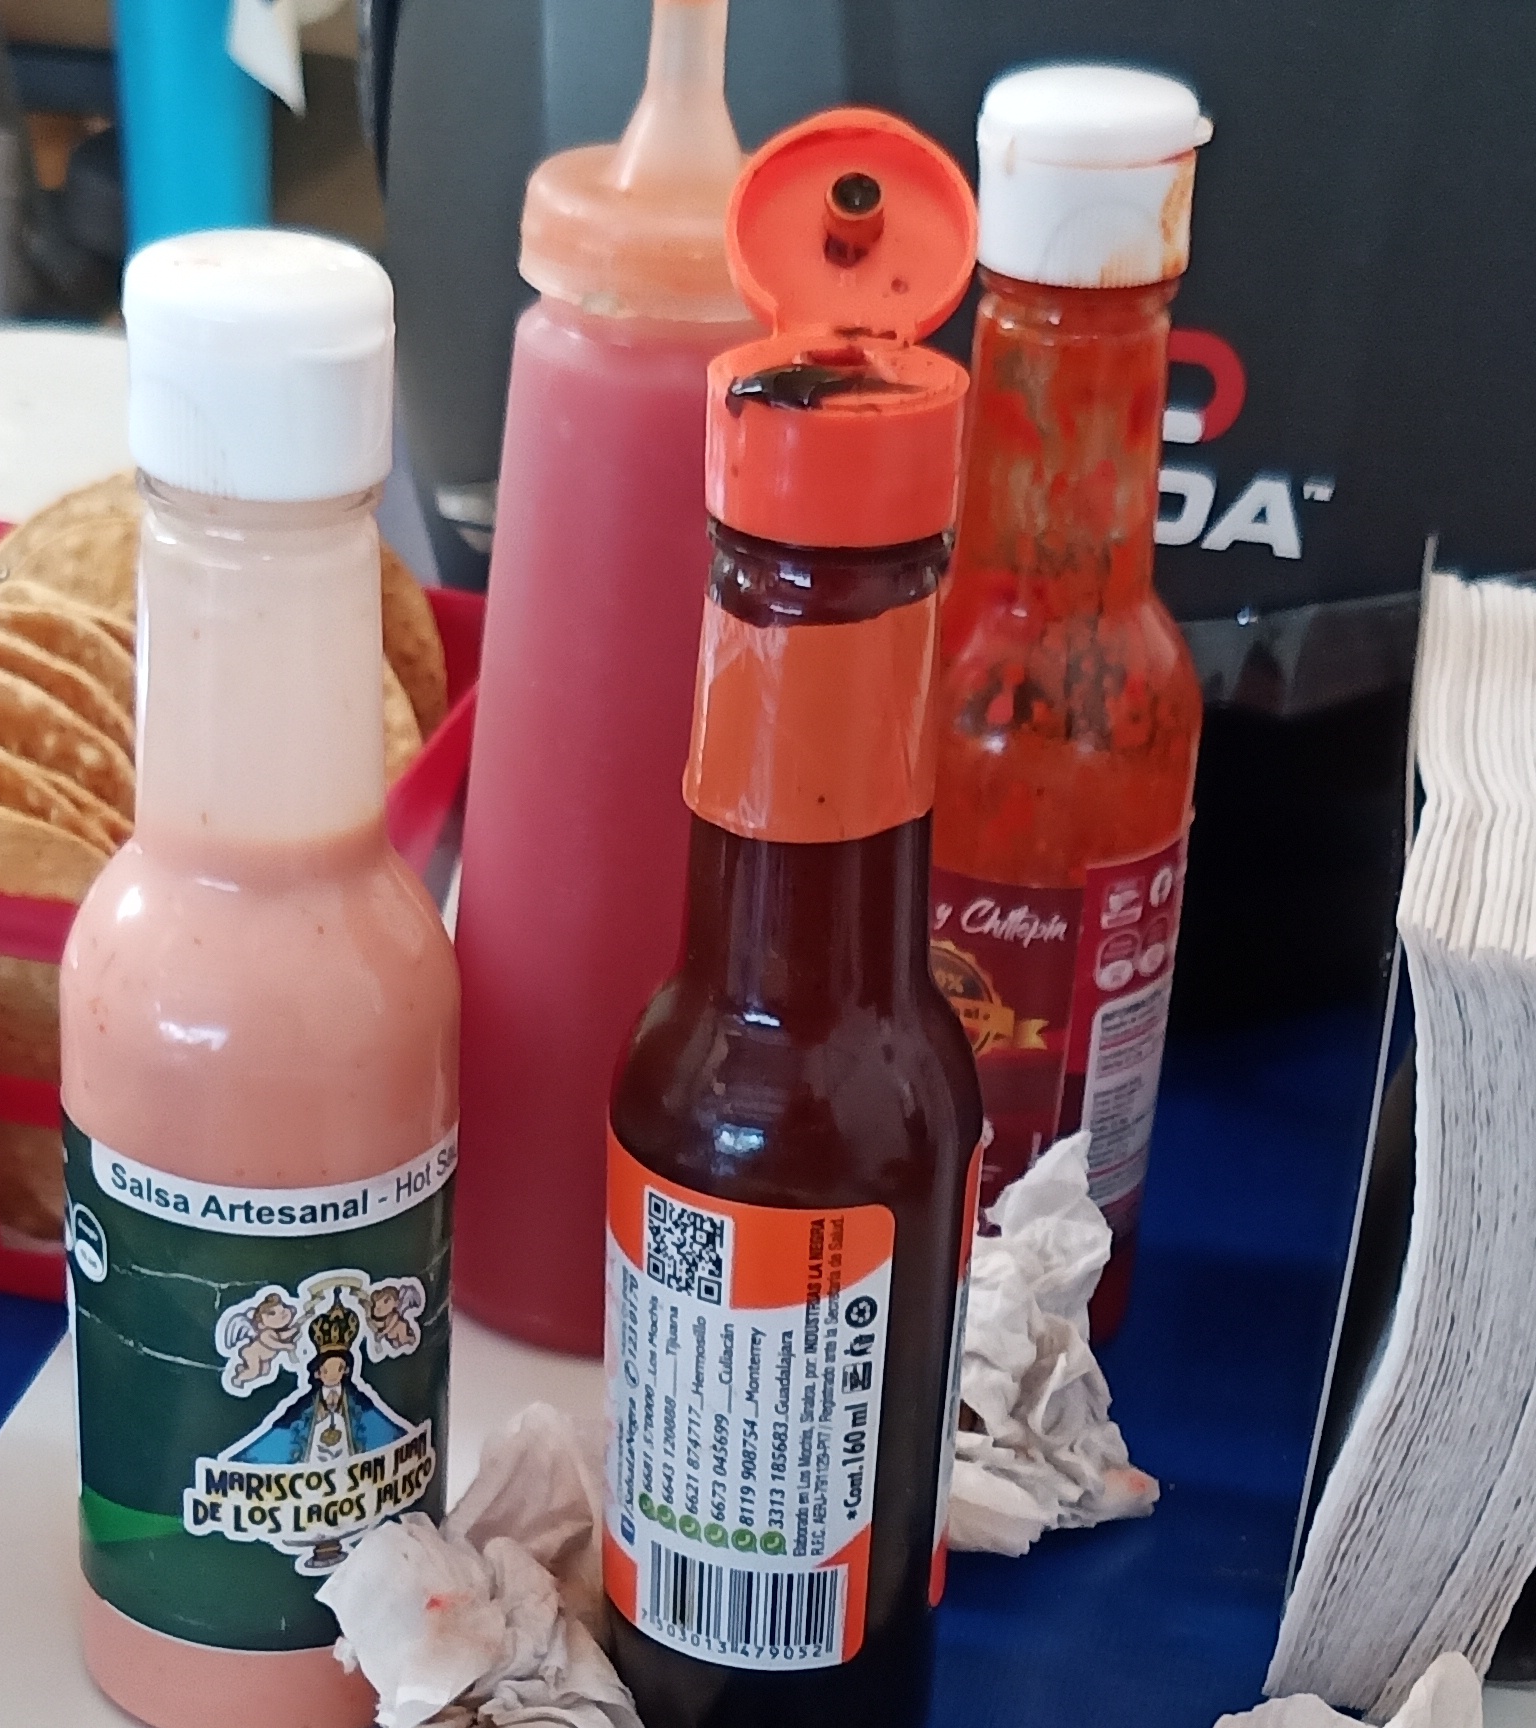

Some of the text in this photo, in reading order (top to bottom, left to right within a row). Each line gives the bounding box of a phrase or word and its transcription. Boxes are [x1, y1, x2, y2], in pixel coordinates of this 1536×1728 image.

[110, 1162, 191, 1215] Salsa
[200, 1188, 369, 1225] Artesanal
[395, 1161, 432, 1204] Hot
[809, 1218, 825, 1260] NEGRA
[829, 1253, 842, 1268] de
[808, 1263, 823, 1279] LA
[804, 1283, 822, 1354] INDUSTRIAS
[824, 1328, 838, 1338] la
[824, 1341, 836, 1363] ante
[642, 1451, 653, 1493] 6681
[648, 1350, 657, 1376] Los
[662, 1306, 681, 1504] 6643 120888 Tijuana
[685, 1316, 706, 1515] 6621 874717 Hermosillo
[818, 1367, 836, 1422] Registrado
[844, 1401, 868, 1428] ml
[710, 1323, 734, 1522] 6673 045699 Culiacán
[739, 1327, 767, 1527] 8119 908754 Monterrey
[768, 1330, 796, 1529] 3313 185683 Guadalajara
[205, 1431, 428, 1502] MARISCOS SAN JUAN
[796, 1470, 810, 1490] Los
[192, 1457, 432, 1535] DE LOS LAGOS JALISCO
[798, 1492, 809, 1504] en
[792, 1507, 808, 1557] Elaborado
[655, 1614, 728, 1655] 503013
[739, 1643, 824, 1661] 479052
